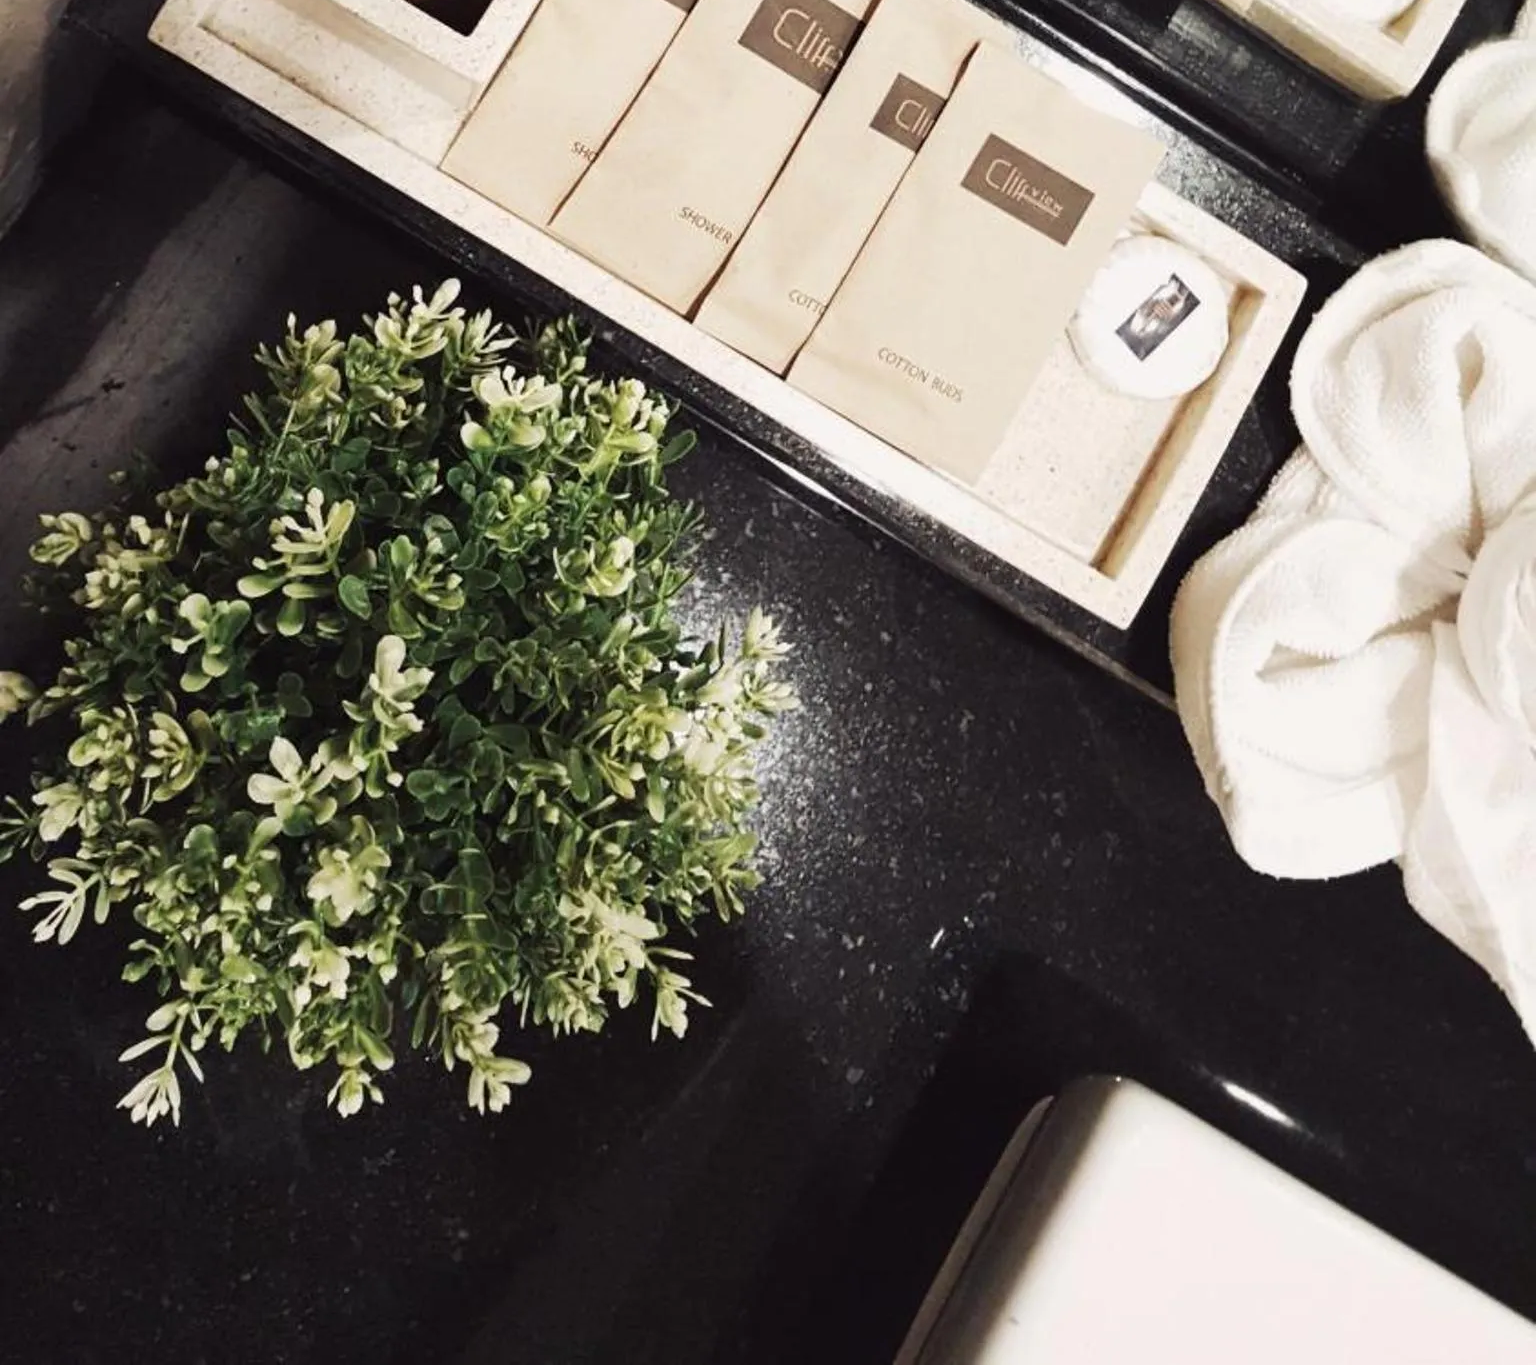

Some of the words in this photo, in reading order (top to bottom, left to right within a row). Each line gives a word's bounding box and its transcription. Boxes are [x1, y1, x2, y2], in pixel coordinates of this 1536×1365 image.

[679, 206, 733, 244] SHOWER
[877, 346, 930, 384] COTTON
[931, 376, 964, 403] BUDS
